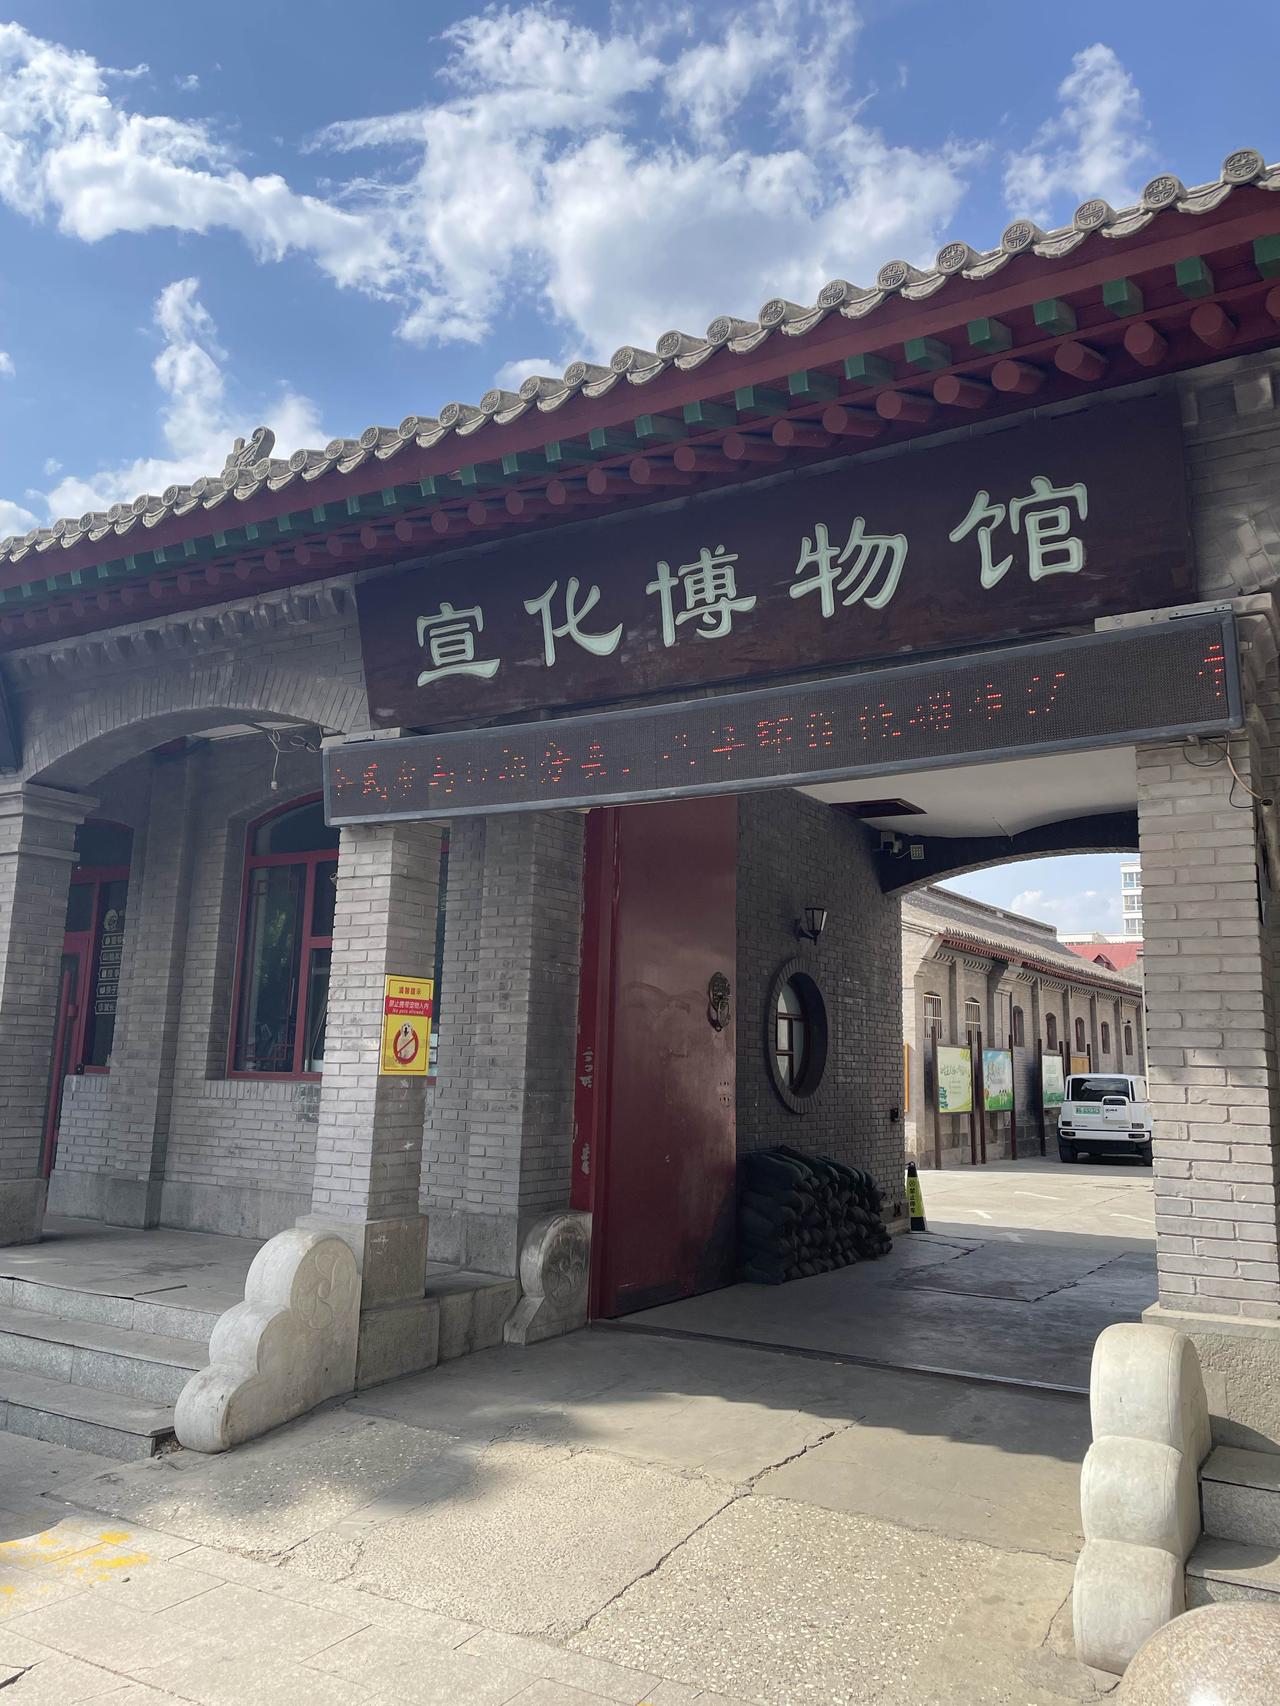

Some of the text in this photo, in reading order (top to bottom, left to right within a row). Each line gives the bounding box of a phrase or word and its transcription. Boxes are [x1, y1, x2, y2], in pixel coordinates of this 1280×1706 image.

[416, 475, 1090, 687] 宣化博物馆
